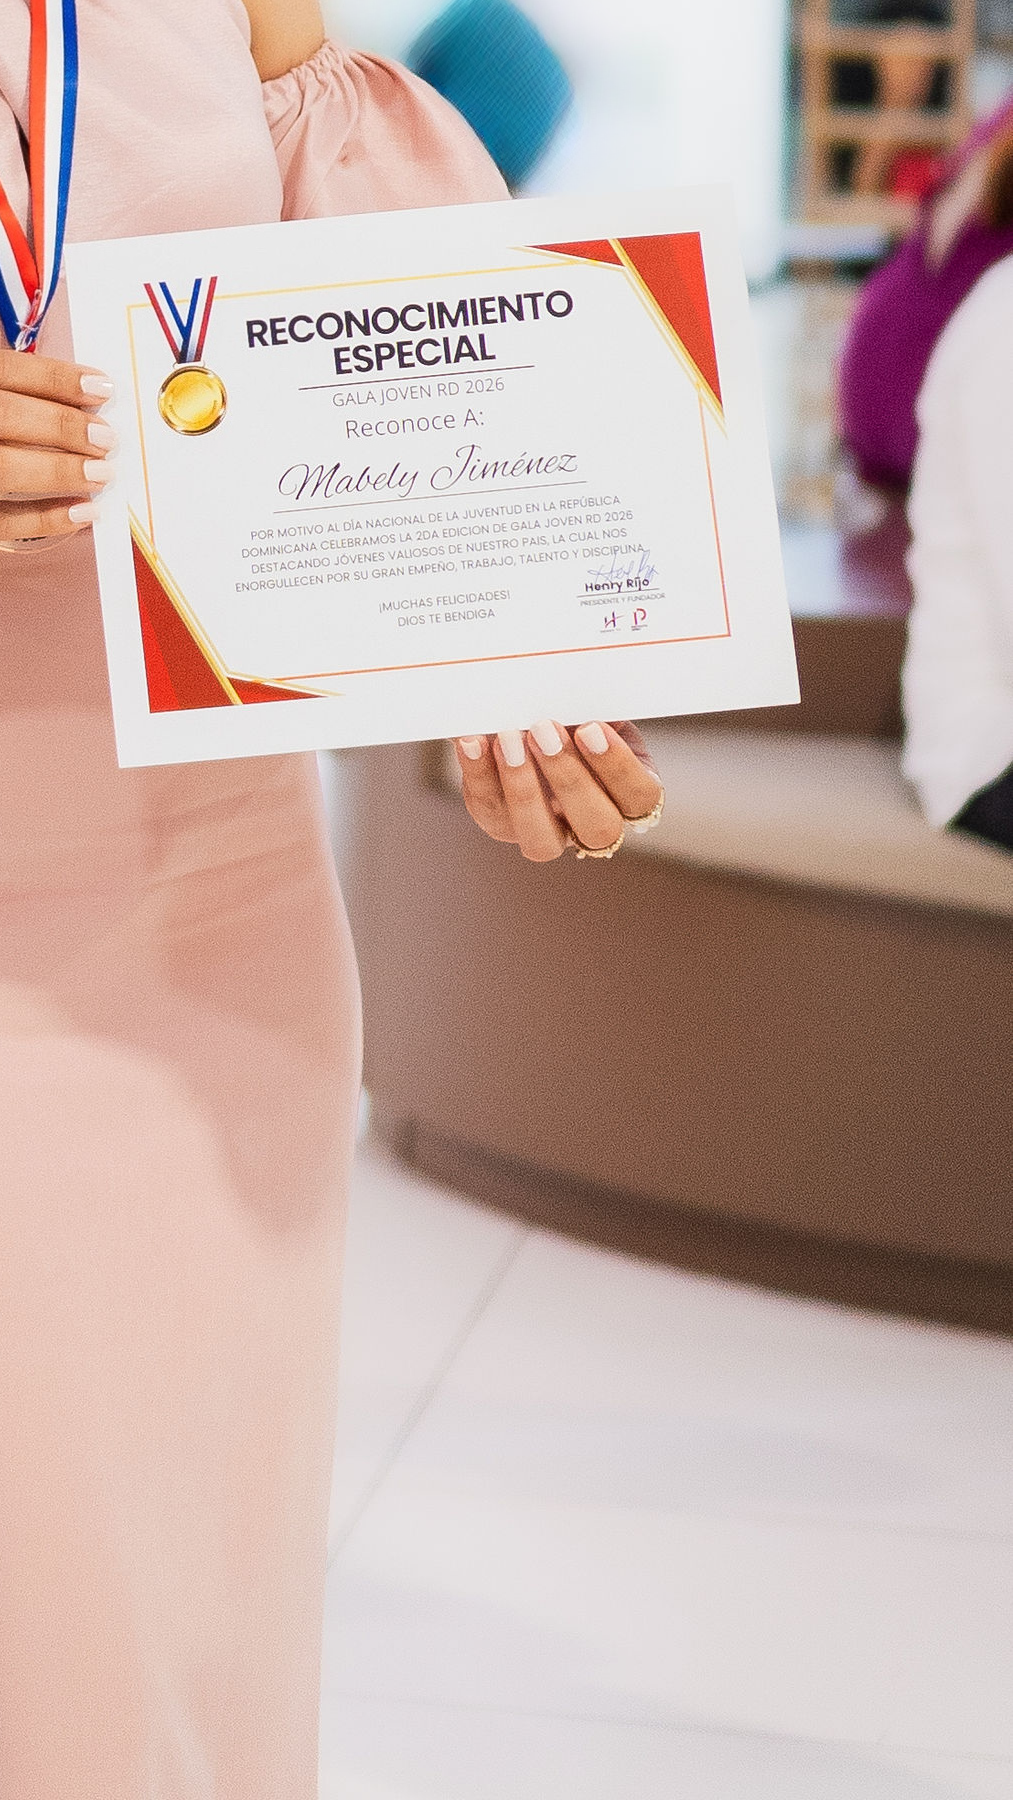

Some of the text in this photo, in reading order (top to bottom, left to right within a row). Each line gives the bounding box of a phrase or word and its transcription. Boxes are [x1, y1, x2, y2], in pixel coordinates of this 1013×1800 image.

[246, 290, 573, 348] RECONOCIMIENTO
[334, 334, 496, 375] ESPECIAL
[333, 377, 505, 407] GALA JOVEN RD 2026
[346, 409, 484, 439] Reconoce A:
[278, 444, 577, 498] Mabely Jiménez
[242, 510, 633, 559] DOMINICANA CELEBRAMOS LA 2DA EDICION DE GALA JOVEN RD 2026
[251, 496, 621, 541] POR MOTIVO AL DÍA NACIONAL DE LA JUVENTUD EN LA REPÚBLICA
[235, 574, 324, 593] ENORGULLECEN
[327, 569, 351, 583] POR
[353, 570, 369, 581] SU
[371, 566, 405, 579] GRAN
[408, 560, 458, 576] EMPEÑO,
[460, 556, 517, 570] TRABAJO,
[518, 550, 570, 564] TALENTO
[572, 549, 579, 559] Y
[251, 528, 627, 575] DESTACANDO JÓVENES VALIOSOS DE NUESTRO PAIS, LA CUAL NOS
[379, 590, 510, 613] ¡MUCHAS FELICIDADES!
[585, 576, 650, 593] Henry Rijo
[398, 609, 495, 627] DIOS TE BENDIGA
